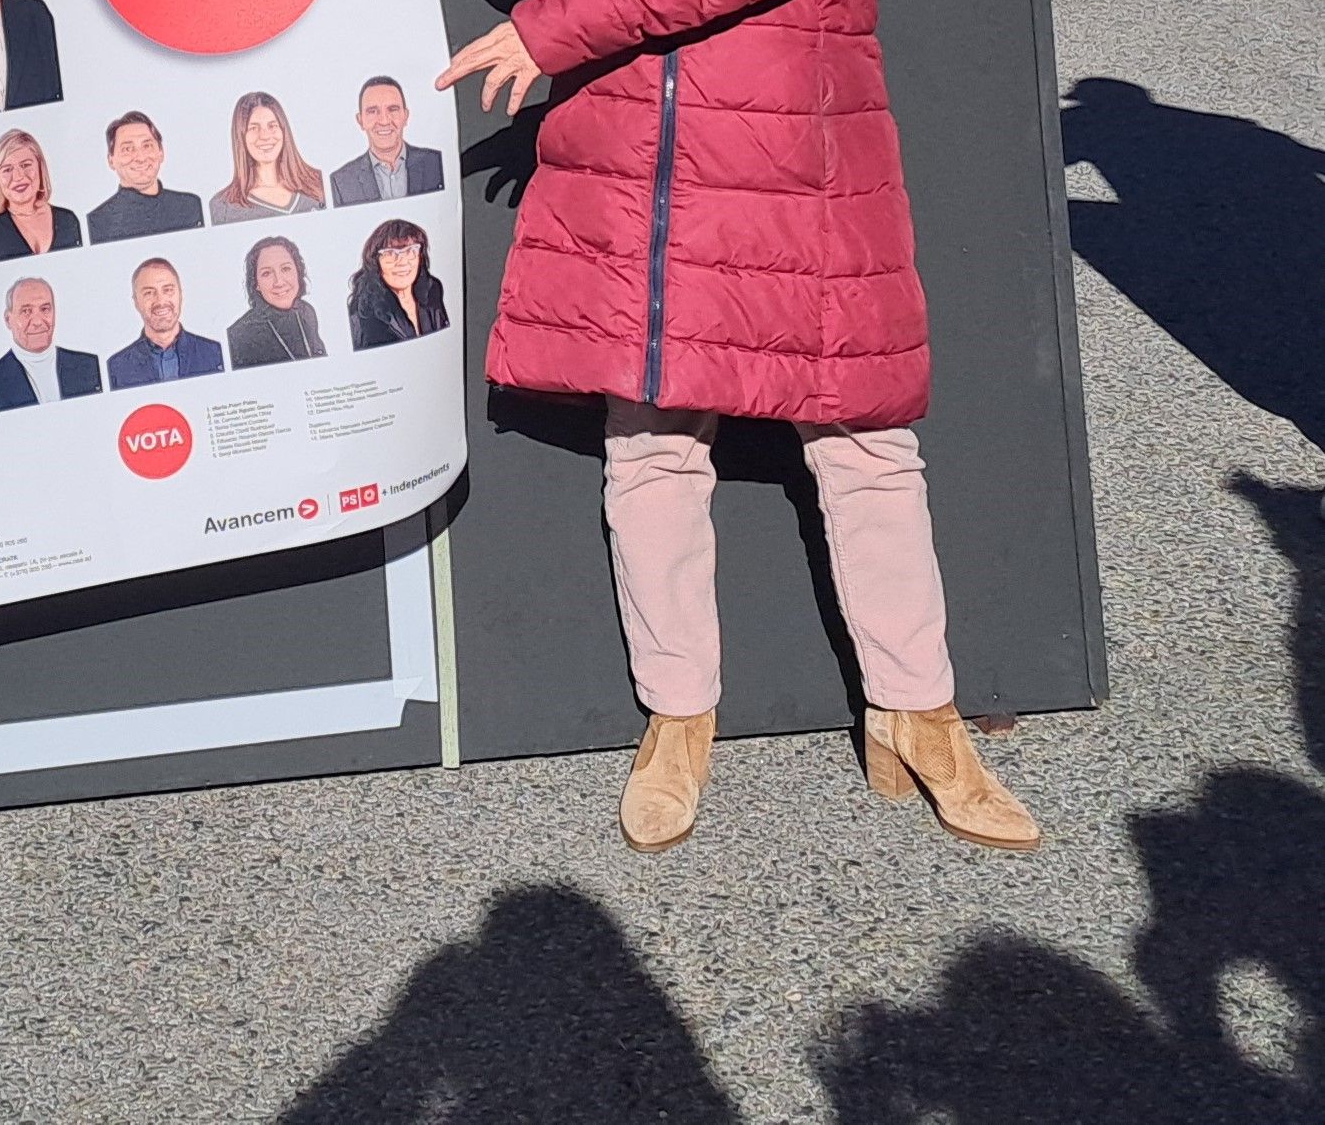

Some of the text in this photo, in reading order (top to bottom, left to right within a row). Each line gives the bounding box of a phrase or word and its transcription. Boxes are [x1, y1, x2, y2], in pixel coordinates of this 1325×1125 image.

[125, 427, 185, 453] VOTA
[342, 494, 358, 507] PS
[389, 462, 450, 495] Independents
[204, 504, 295, 535] Avancem
